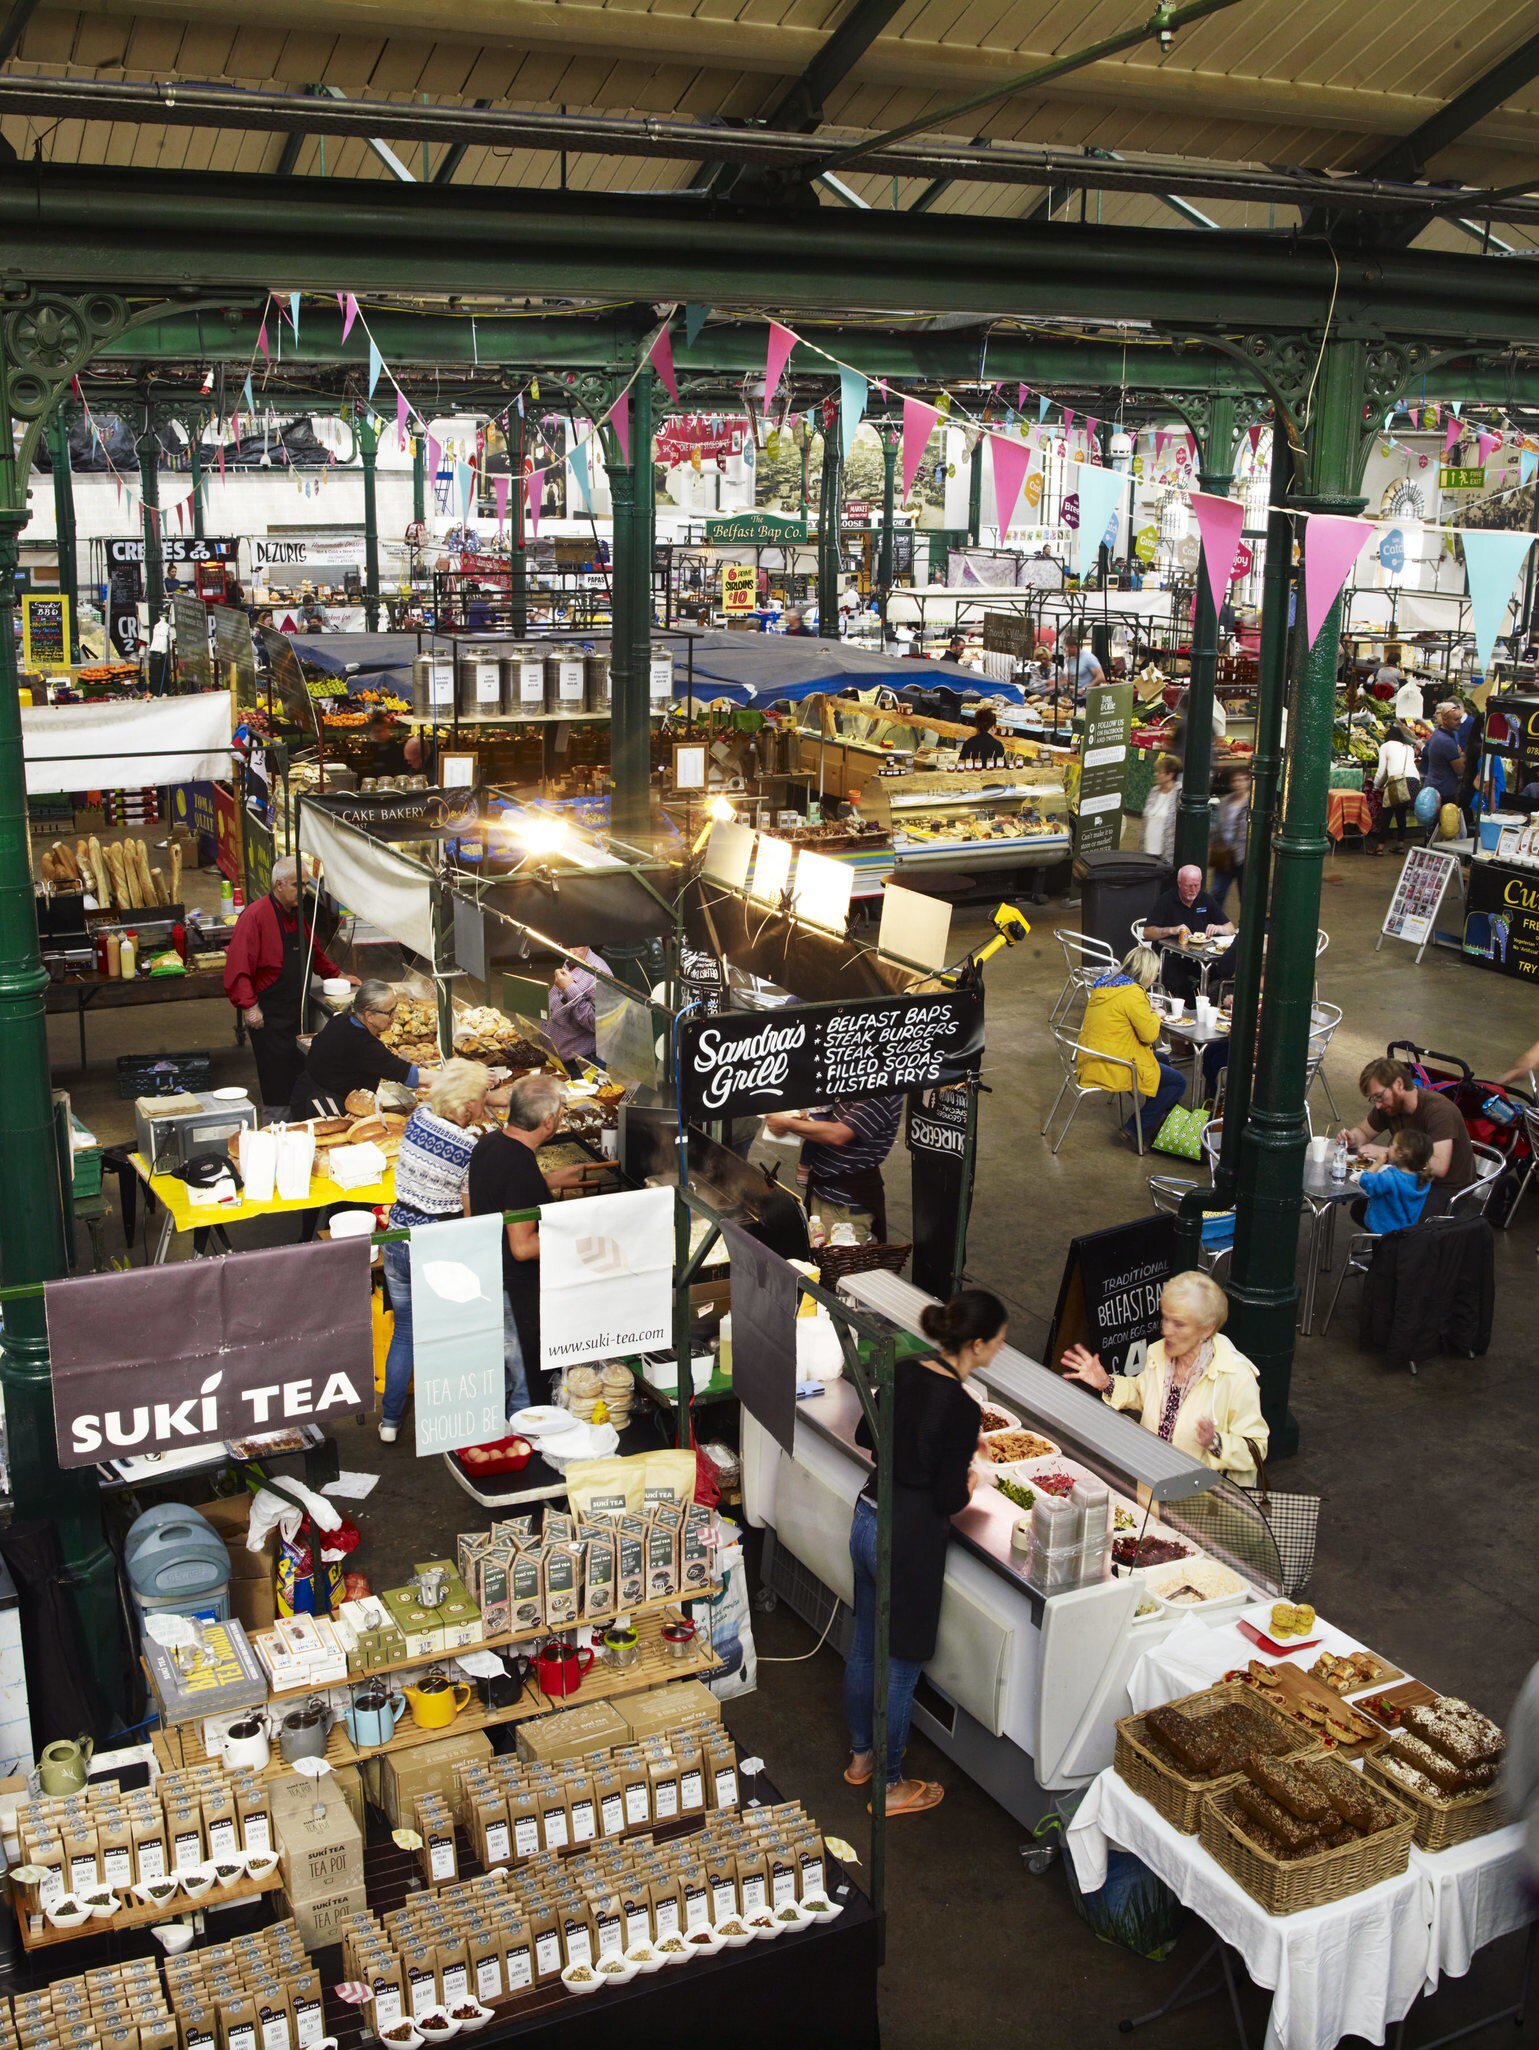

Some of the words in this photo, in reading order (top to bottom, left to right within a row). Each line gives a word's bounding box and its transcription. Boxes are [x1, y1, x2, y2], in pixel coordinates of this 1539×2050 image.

[751, 515, 764, 523] The
[841, 519, 864, 527] OOSE
[713, 525, 754, 542] Belfast
[757, 526, 780, 541] Bap
[784, 526, 802, 539] Co.
[112, 541, 186, 560] CREES
[194, 540, 206, 551] 2
[189, 550, 211, 560] GO
[257, 542, 307, 563] DEZURTS
[728, 568, 737, 581] 6
[725, 580, 754, 591] SIRLOINS
[1098, 719, 1117, 730] FOLLOW
[1104, 727, 1124, 736] FACEBOOK
[1096, 736, 1106, 744] AND
[1106, 733, 1123, 743] TWITTER
[342, 809, 375, 822] CAKE
[381, 806, 427, 820] BAKERY
[1081, 832, 1093, 841] Can't
[1093, 830, 1105, 839] make
[1519, 960, 1538, 975] TRY
[826, 1010, 902, 1034] BELFAST
[904, 1005, 952, 1025] BAPS
[823, 1029, 874, 1048] STEAK
[879, 1021, 959, 1042] BURGERS
[694, 1019, 807, 1074] Sandra's
[823, 1045, 874, 1064] STEAK
[885, 1037, 934, 1055] SUBS
[827, 1060, 878, 1081] FILLED
[883, 1051, 945, 1072] SODAS
[702, 1053, 789, 1109] Grill
[825, 1074, 889, 1095] ULSTER
[894, 1065, 941, 1086] FRYS
[1102, 1259, 1170, 1293] TRADITIONAL
[1097, 1287, 1144, 1327] BELFAST
[1146, 1282, 1165, 1315] BA
[548, 1326, 665, 1357] www.suki-tea.com
[423, 1377, 451, 1406] TEA
[457, 1373, 478, 1399] AS
[483, 1368, 495, 1395] IT
[71, 1369, 224, 1453] SUKÍ
[241, 1371, 362, 1424] TEA
[420, 1409, 476, 1446] SHOULD
[482, 1405, 500, 1433] BE
[645, 1490, 659, 1499] UKÍ
[214, 1661, 245, 1687] TEA
[288, 1789, 300, 1798] TEA
[302, 1786, 313, 1794] POT
[305, 1824, 317, 1833] TEA
[318, 1821, 330, 1830] POT
[308, 1847, 328, 1860] SUKÍ
[328, 1845, 345, 1853] TEA
[309, 1862, 328, 1878] TEA
[330, 1854, 347, 1873] POT
[312, 1898, 331, 1911] SUKÍ
[332, 1896, 349, 1905] TEA
[313, 1912, 331, 1929] TEA
